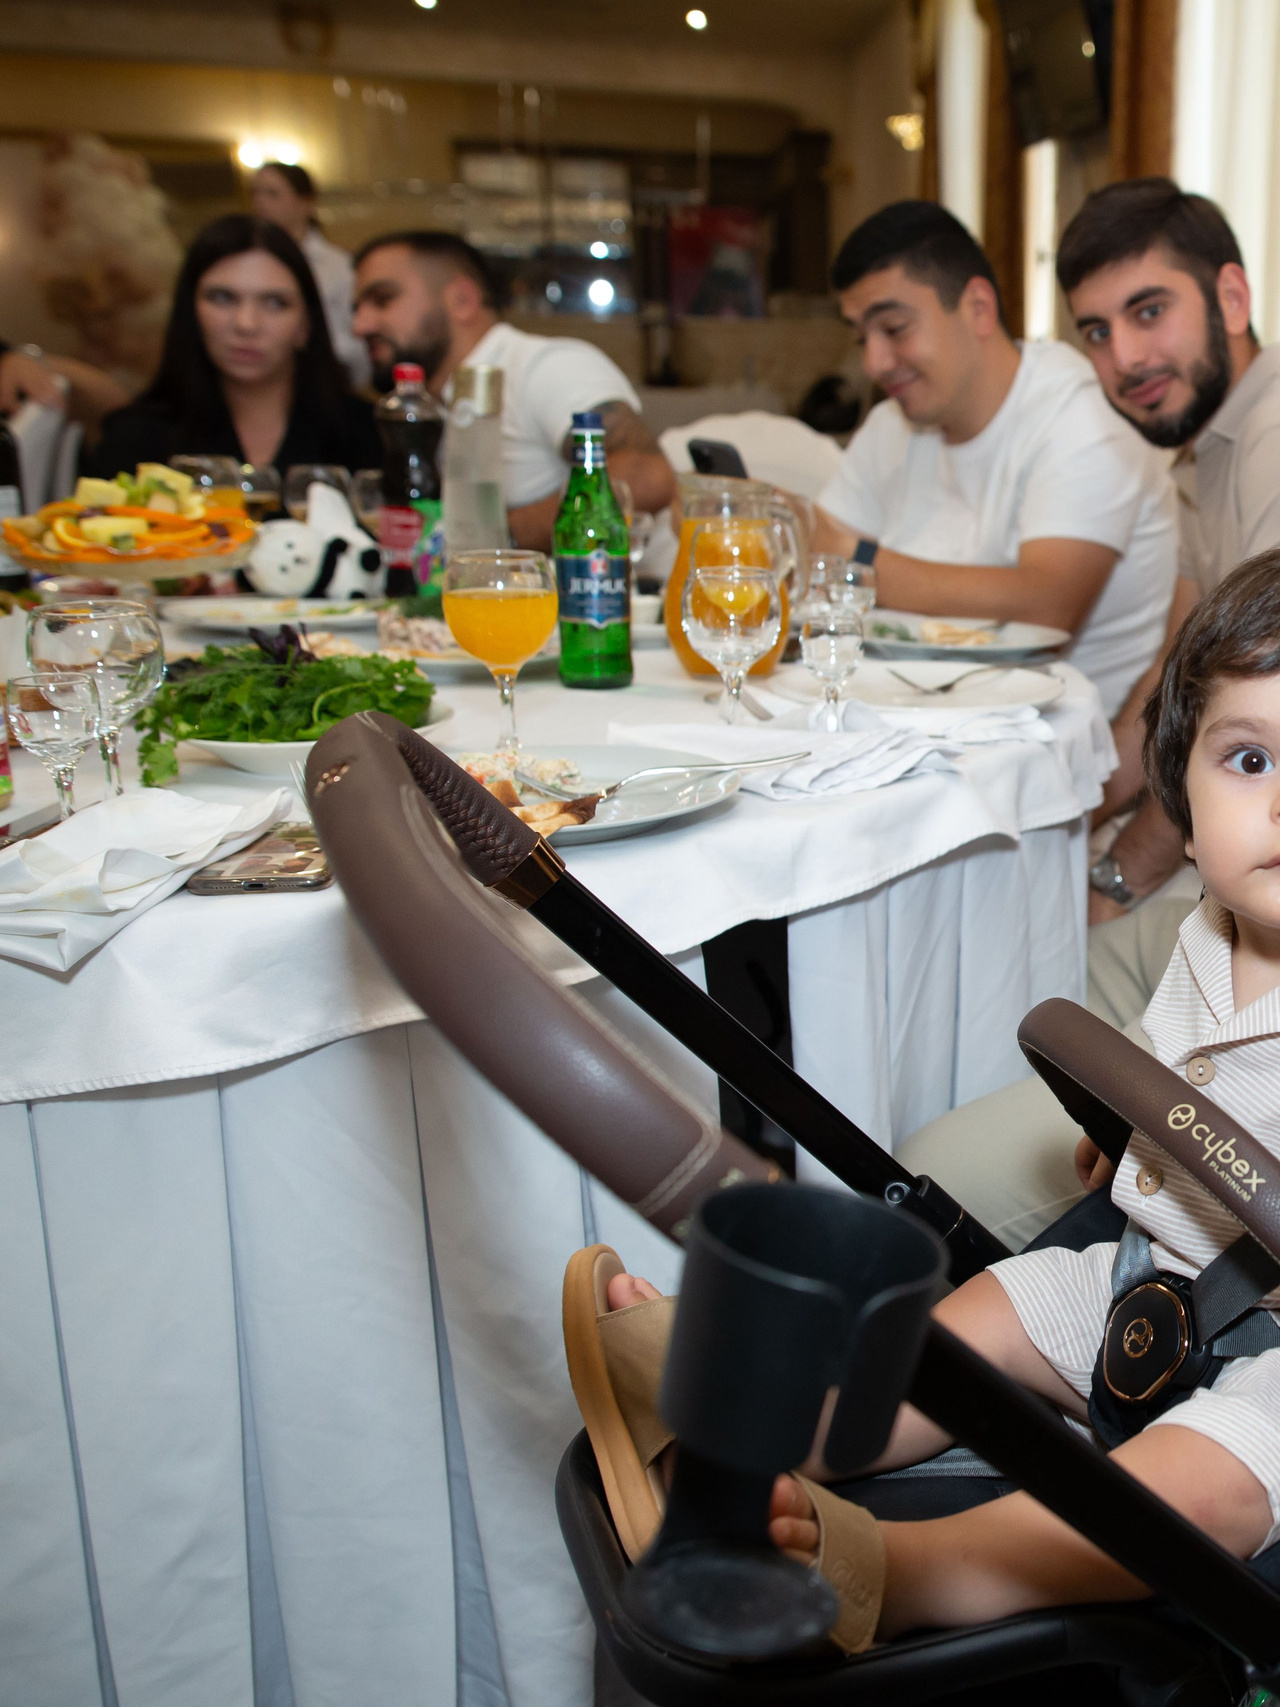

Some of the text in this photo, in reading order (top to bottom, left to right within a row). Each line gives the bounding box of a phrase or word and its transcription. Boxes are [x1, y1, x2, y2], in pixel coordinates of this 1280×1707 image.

[568, 577, 627, 595] JERMUK
[1191, 1123, 1267, 1194] cybex
[1208, 1160, 1252, 1203] PLATINUM
